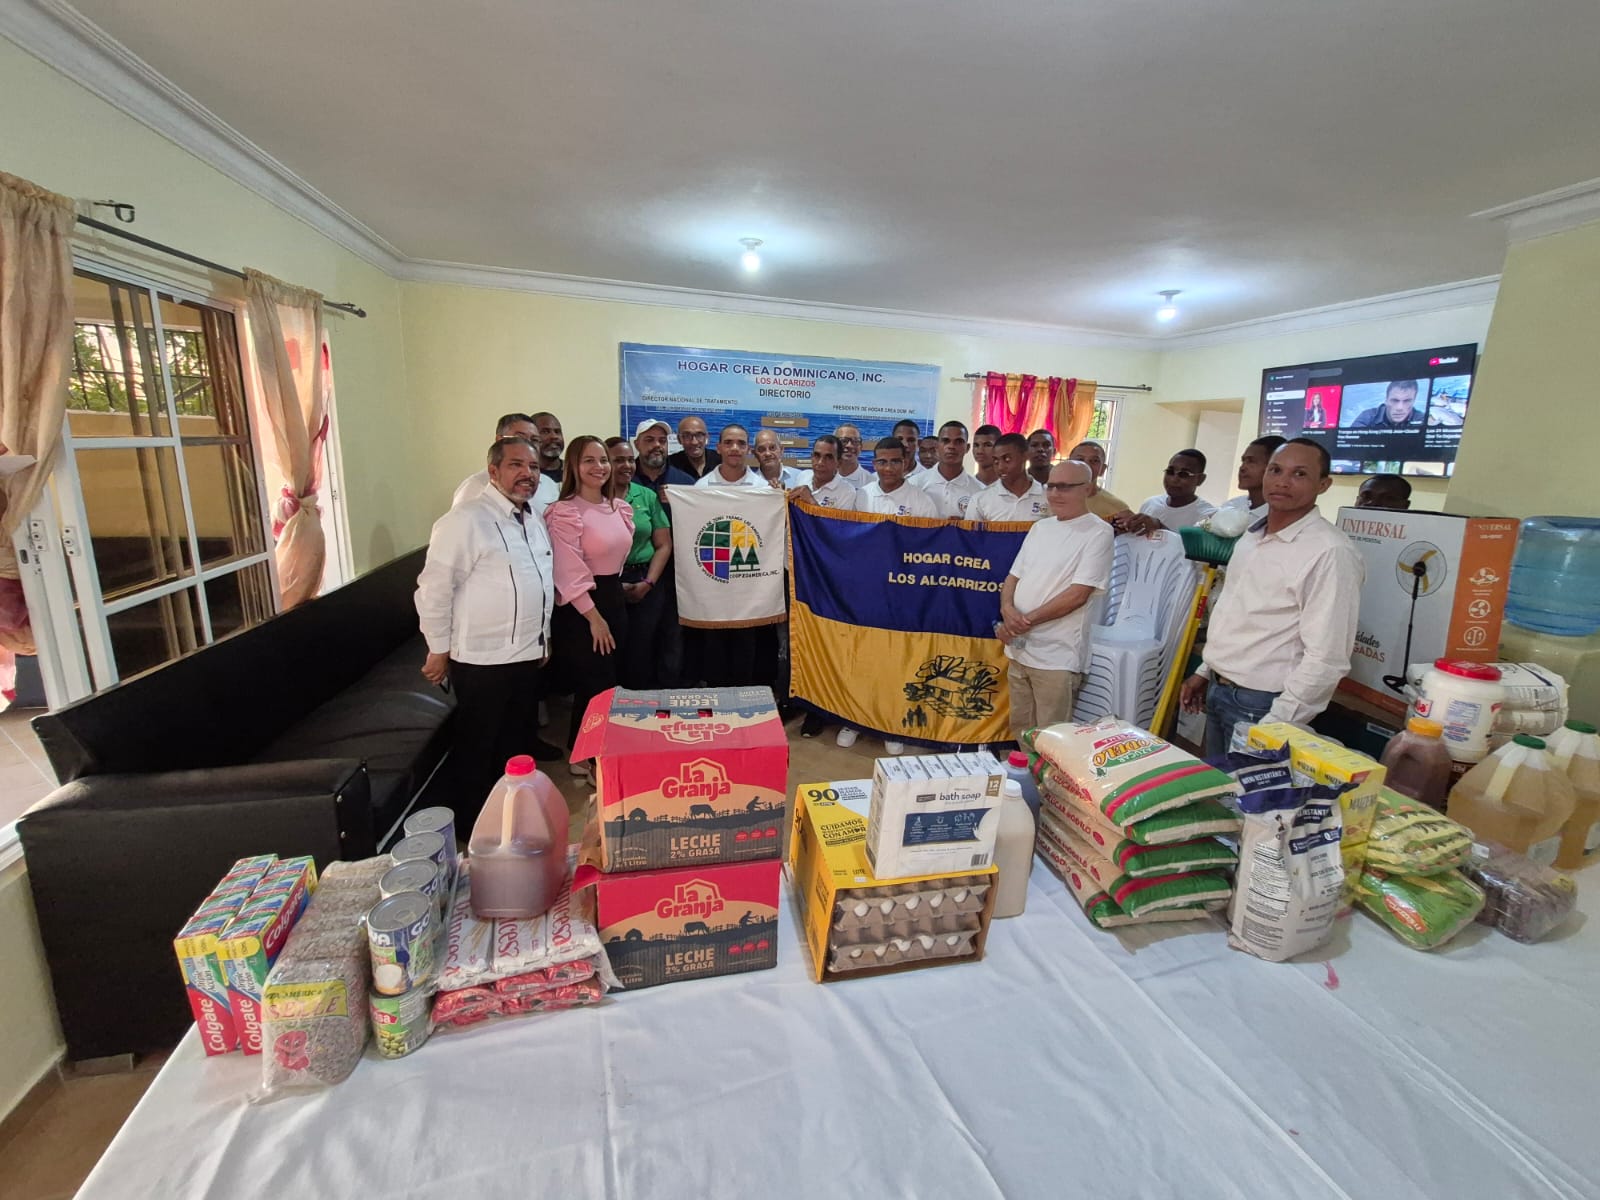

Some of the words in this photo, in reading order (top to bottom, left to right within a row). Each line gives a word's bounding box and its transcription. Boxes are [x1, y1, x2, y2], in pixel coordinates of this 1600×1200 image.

[678, 360, 728, 373] HOGAR
[733, 364, 770, 376] CREA
[773, 366, 858, 382] DOMINICANO,
[862, 372, 886, 383] INC.
[756, 377, 771, 385] LOS
[773, 378, 816, 387] ALCARIZOS
[760, 388, 811, 399] DIRECTORIO
[1342, 518, 1407, 540] UNIVERSAL
[903, 552, 951, 564] HOGAR
[954, 555, 991, 570] CREA
[888, 571, 916, 585] LOS
[1353, 643, 1385, 663] GADAS
[670, 699, 719, 707] LECHE
[683, 765, 705, 781] La
[662, 775, 731, 801] Granja
[807, 788, 840, 802] 90
[939, 791, 960, 801] bath
[961, 791, 981, 801] soap
[820, 818, 863, 831] CUIDAMOS
[670, 833, 721, 851] LECHE
[670, 851, 686, 859] 2%
[688, 847, 721, 858] GRASA
[678, 886, 699, 902] La
[656, 897, 724, 919] Granja
[665, 948, 715, 966] LECHE
[665, 966, 680, 975] 2%
[683, 960, 714, 972] GRASA
[200, 997, 224, 1052] Colgate
[240, 998, 262, 1051] Colgate
